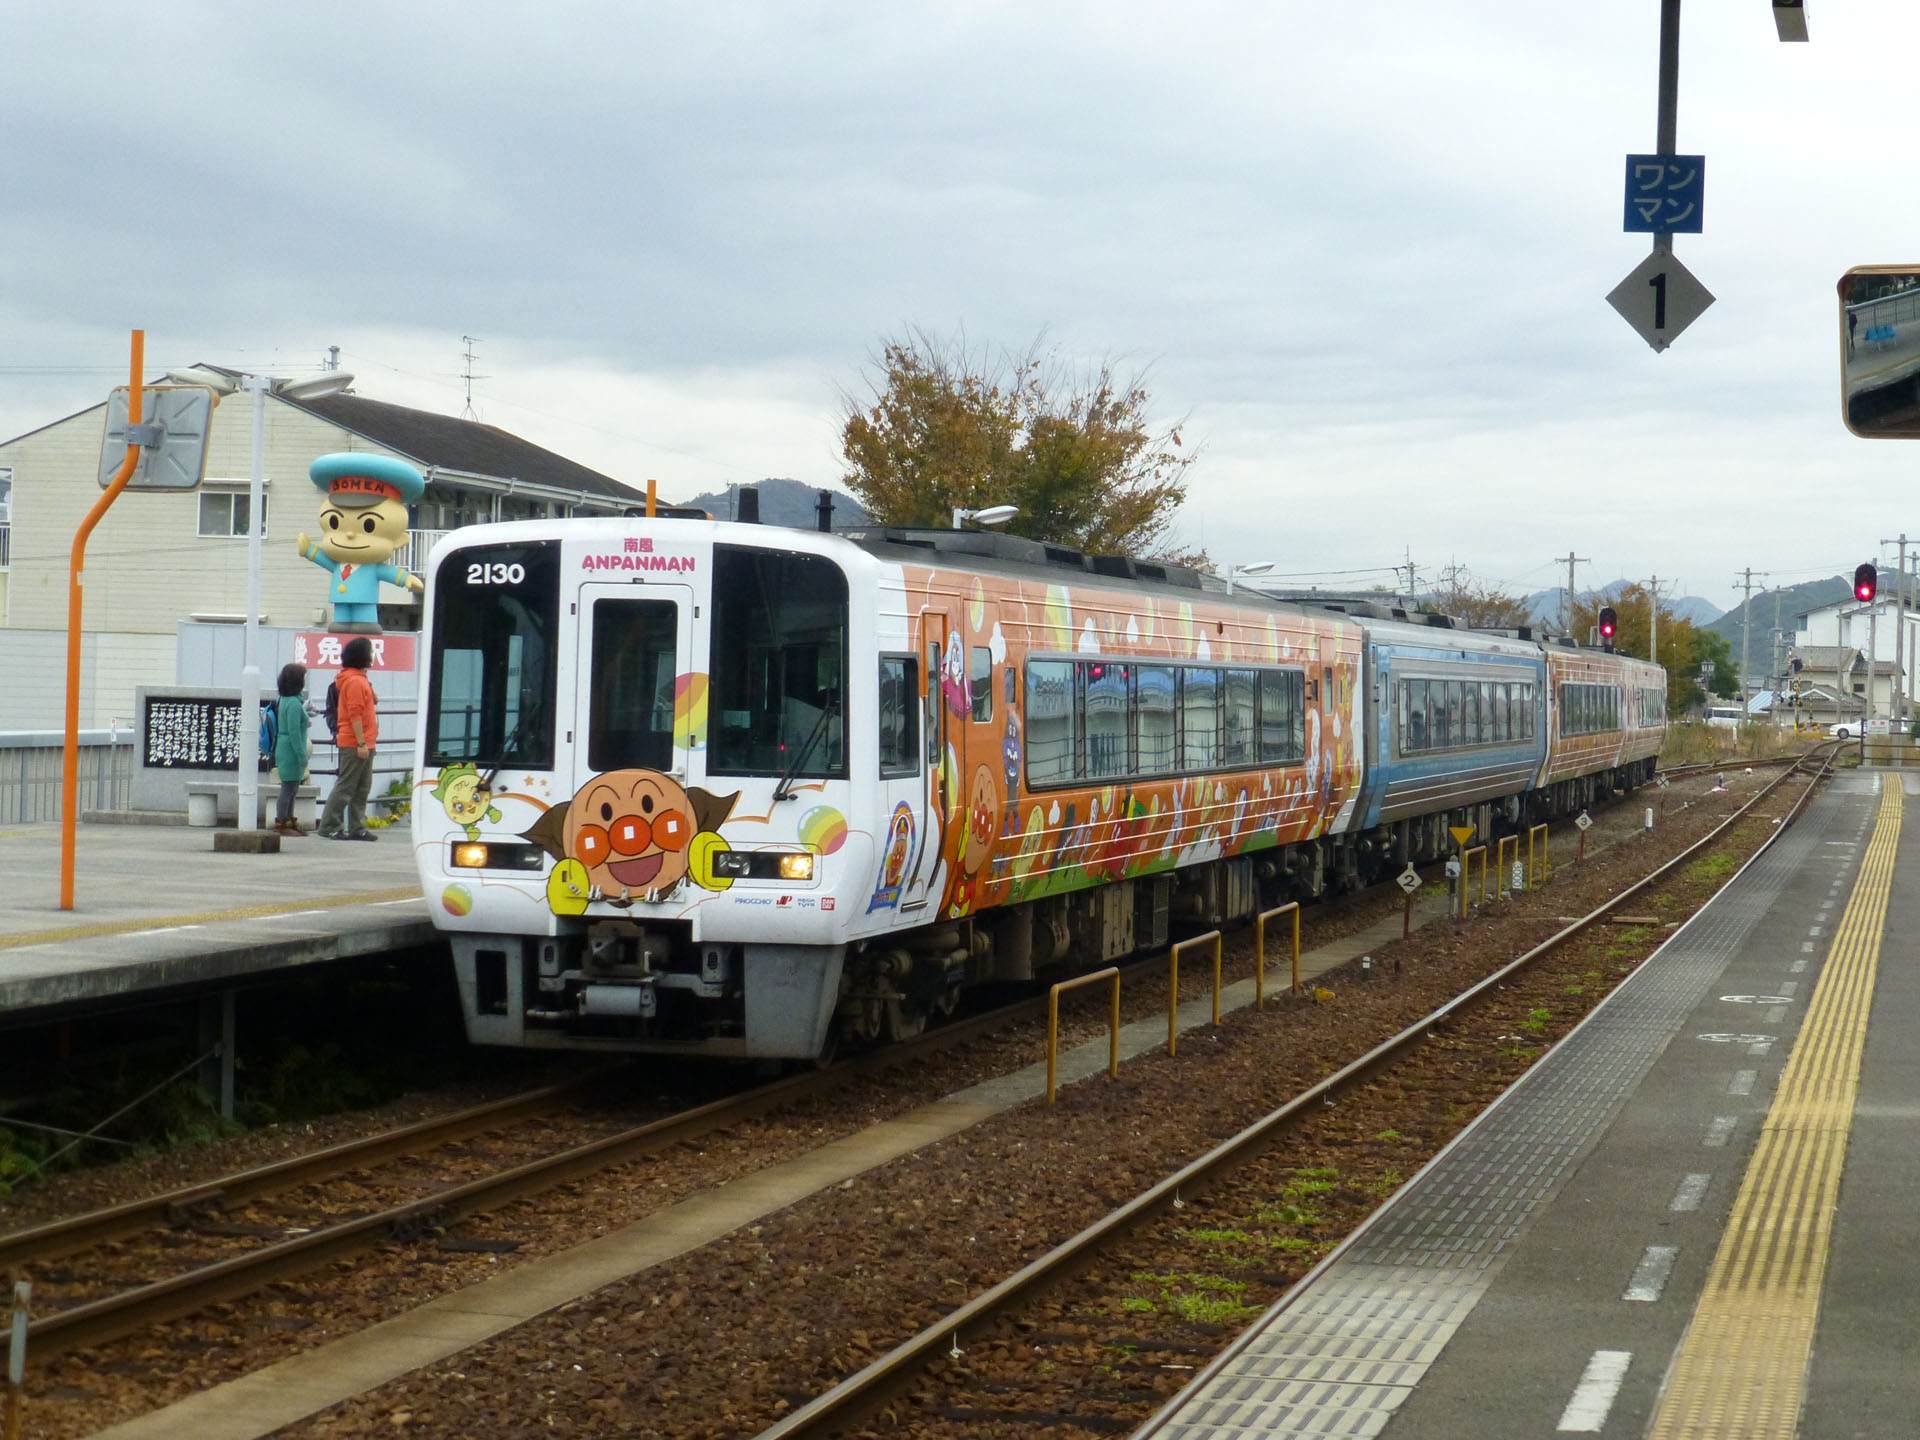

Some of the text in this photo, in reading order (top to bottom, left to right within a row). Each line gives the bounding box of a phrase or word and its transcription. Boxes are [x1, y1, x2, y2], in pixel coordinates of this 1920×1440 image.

[1635, 165, 1696, 191] ワン
[1634, 198, 1695, 224] マン
[1649, 273, 1666, 329] 1
[624, 537, 653, 552] 南風
[582, 555, 695, 572] ANPANMAN
[467, 563, 525, 584] 2130
[1580, 817, 1588, 826] 3
[1403, 875, 1415, 888] 2
[735, 897, 772, 905] PINOCCHIO
